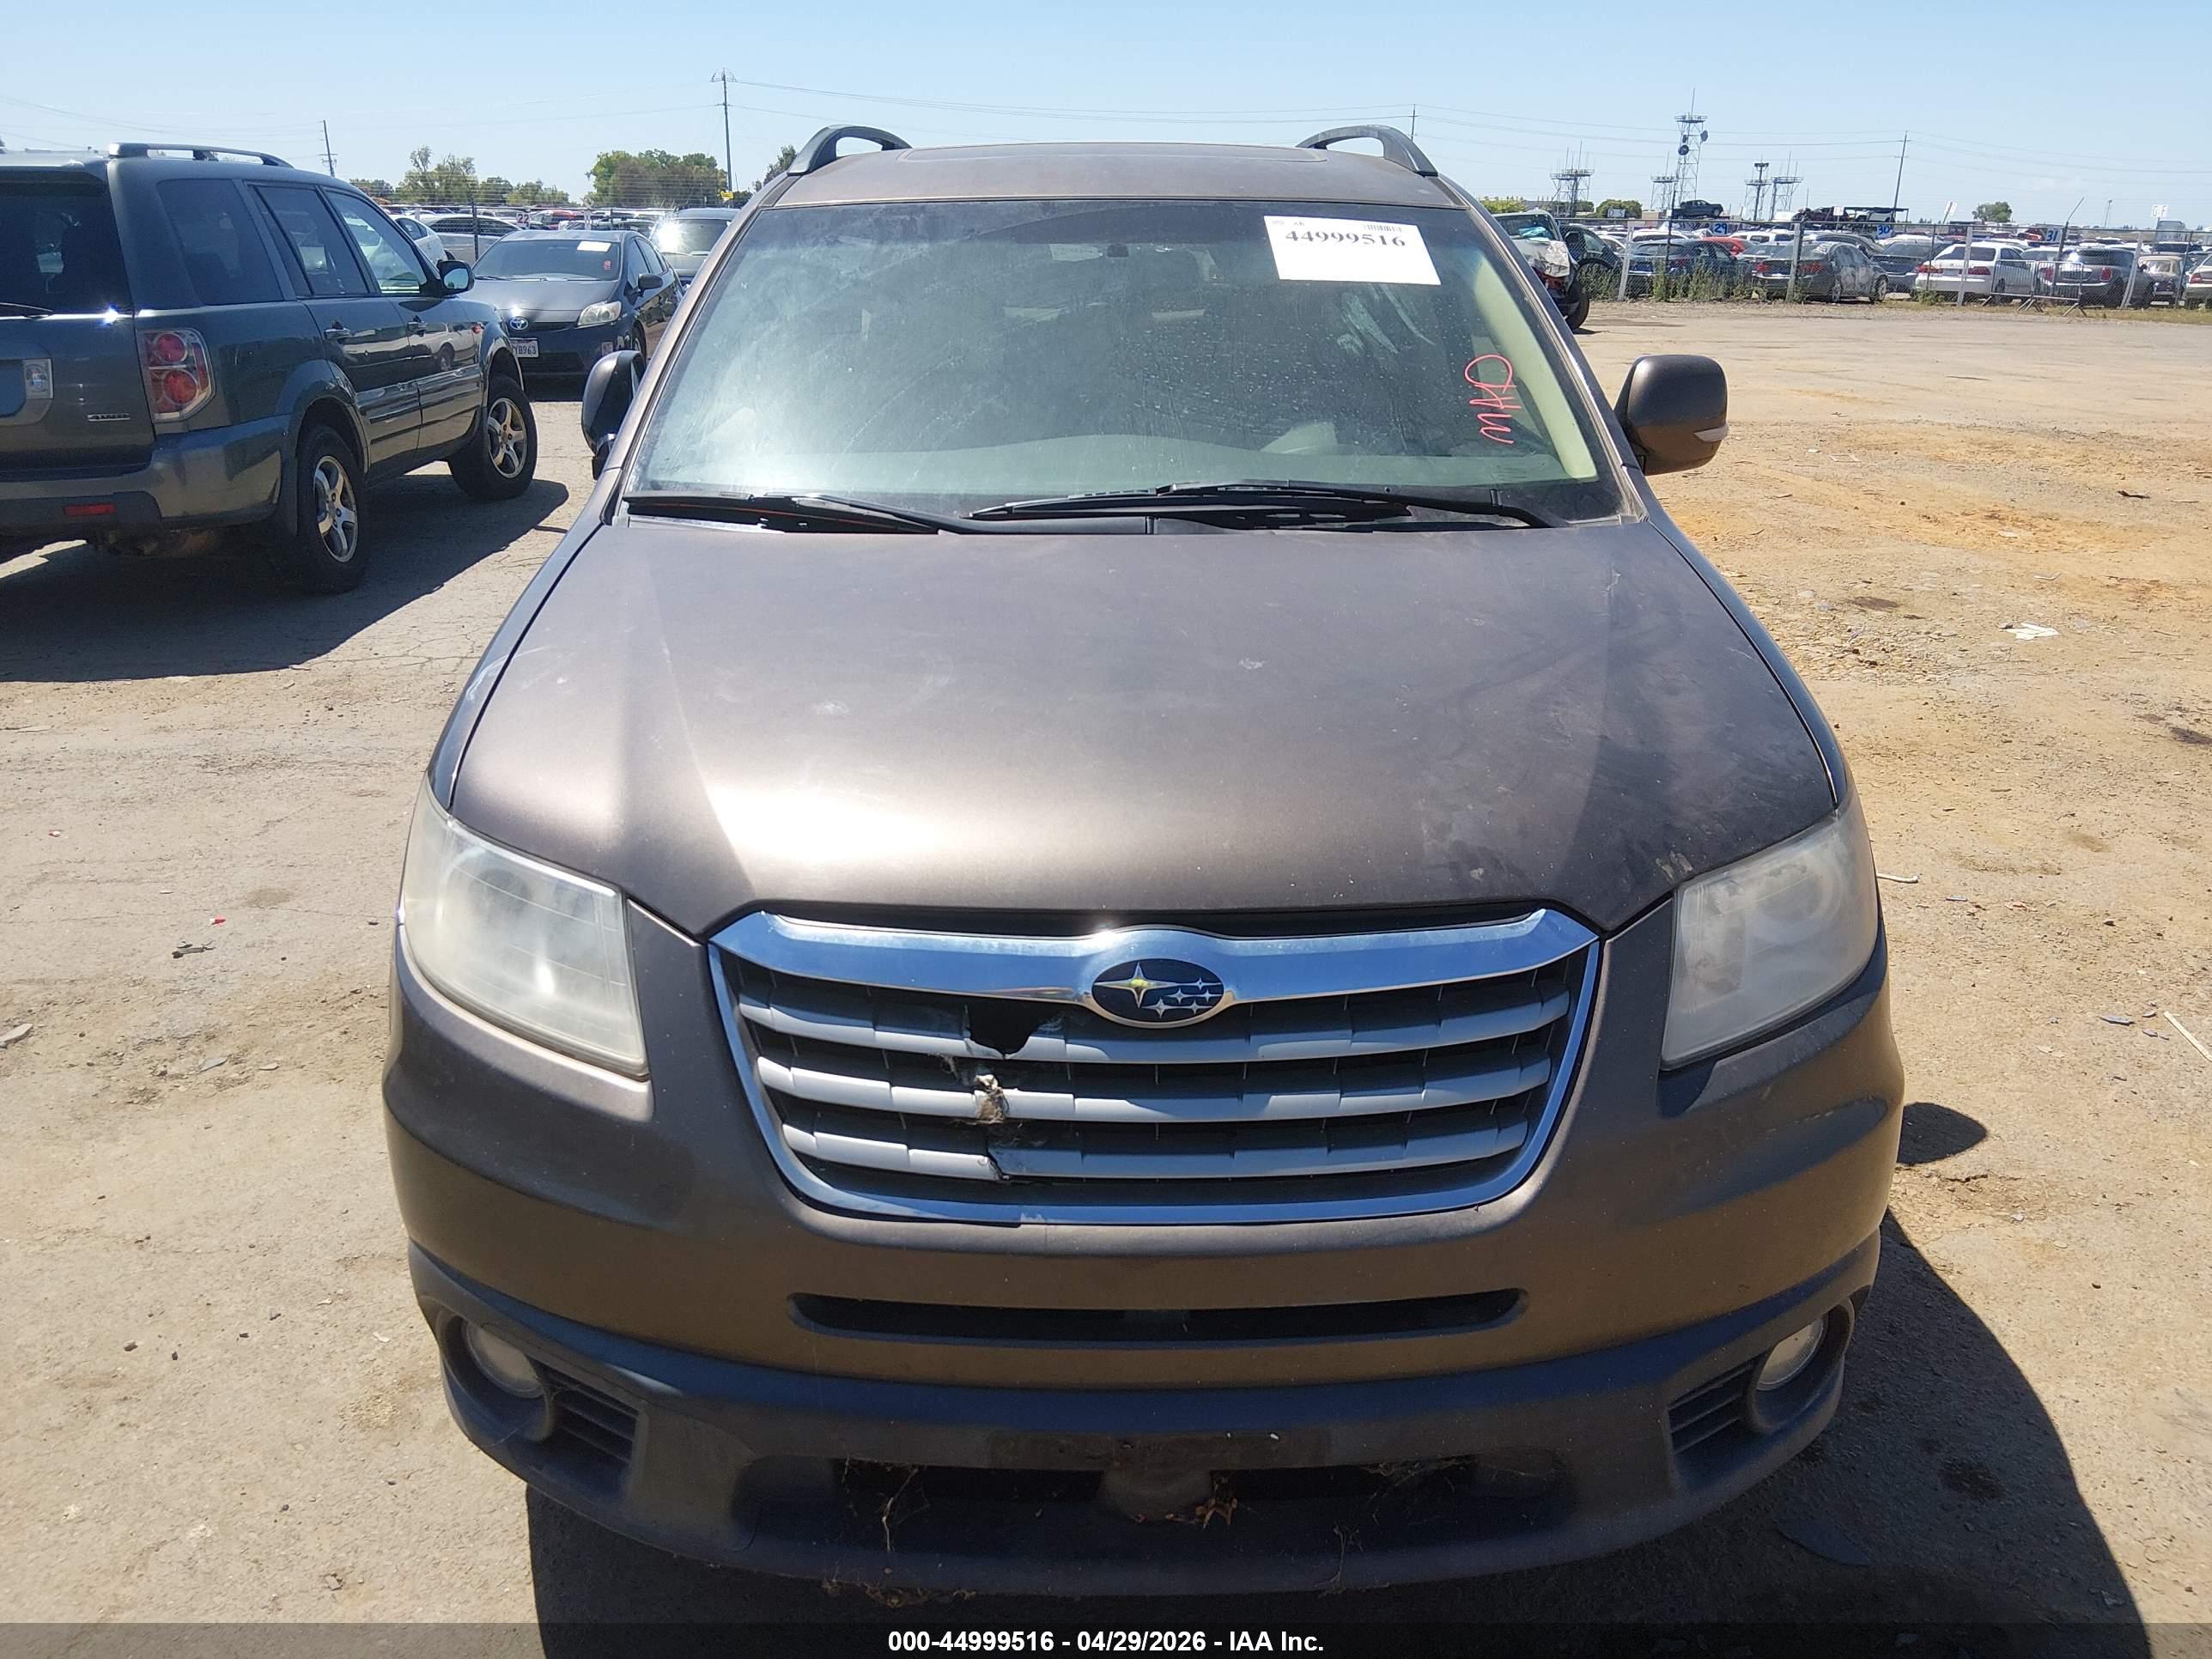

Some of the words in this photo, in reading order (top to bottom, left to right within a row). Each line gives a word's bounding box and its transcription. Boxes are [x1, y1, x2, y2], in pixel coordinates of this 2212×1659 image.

[518, 214, 529, 223] 22
[1714, 223, 1728, 234] 29
[1878, 225, 1890, 235] 30
[1285, 230, 1406, 246] 44999516
[2046, 230, 2058, 241] 31
